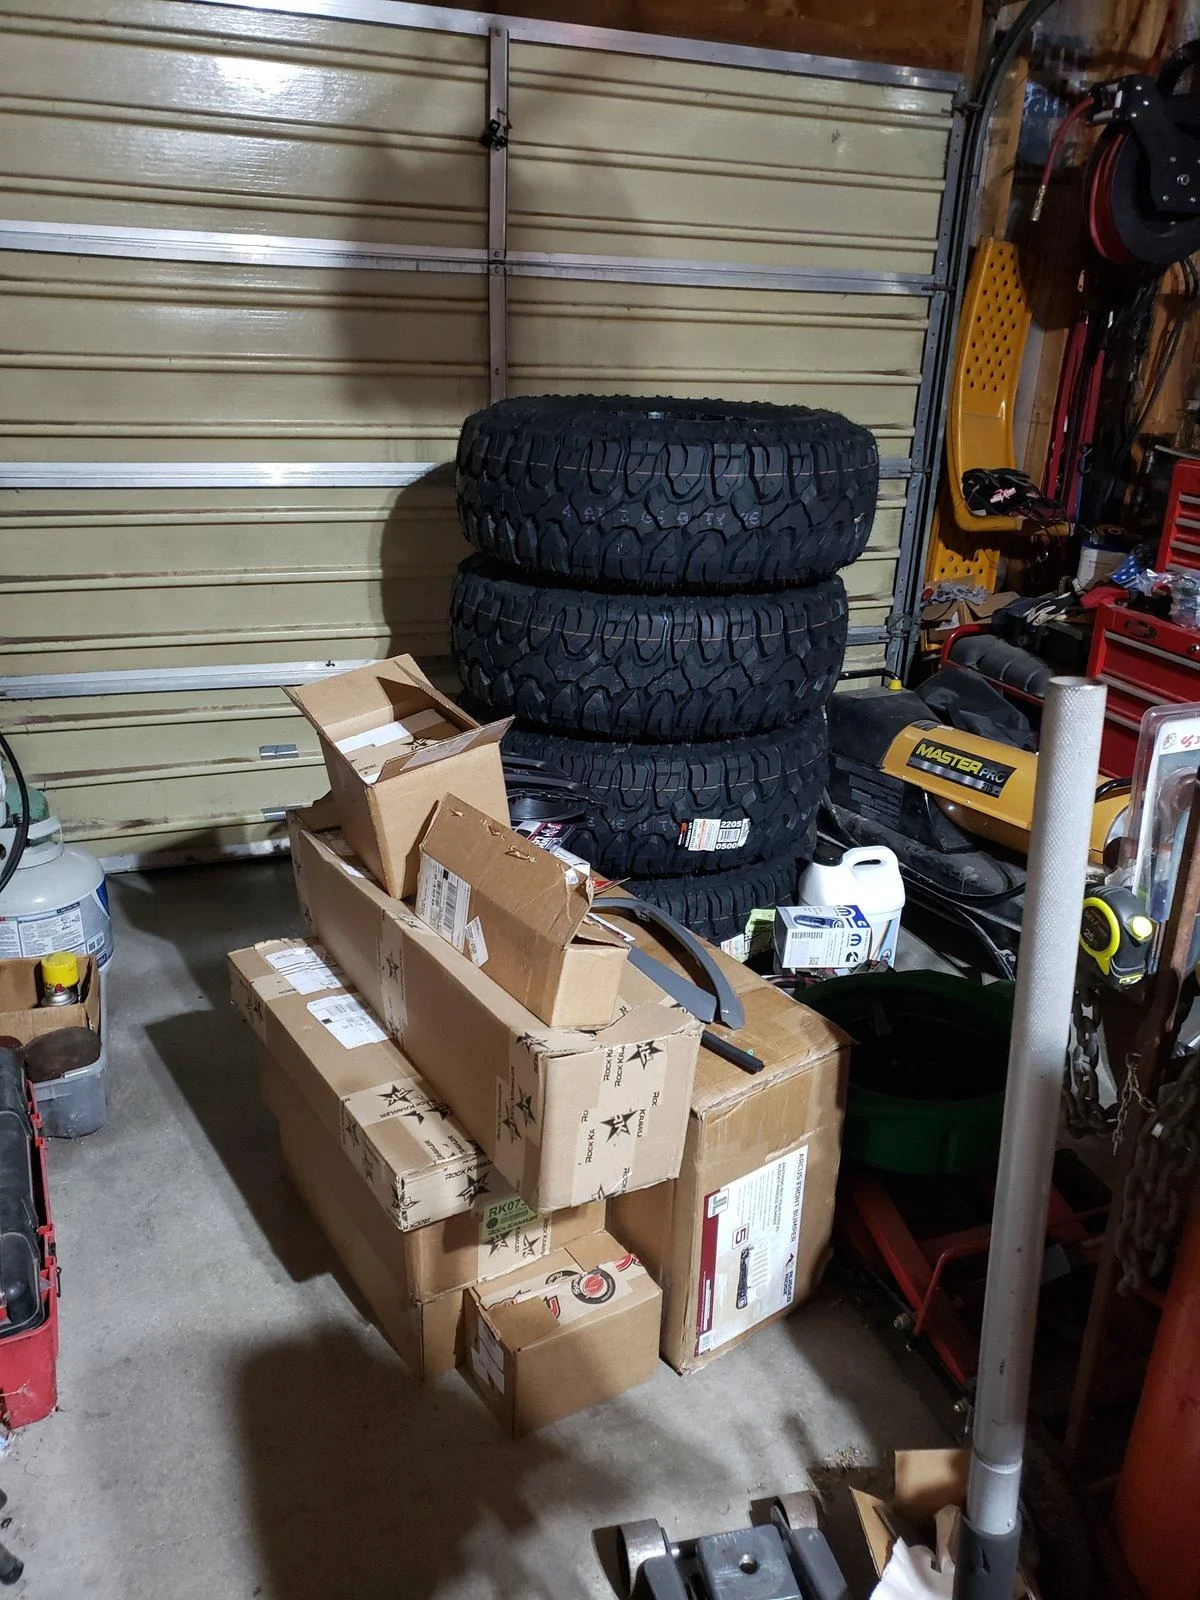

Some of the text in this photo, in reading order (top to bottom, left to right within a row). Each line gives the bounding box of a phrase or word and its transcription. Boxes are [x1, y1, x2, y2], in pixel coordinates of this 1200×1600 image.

[915, 743, 1006, 783] MASTER PRO
[980, 782, 994, 792] 215
[720, 821, 742, 829] 2205
[603, 1058, 613, 1082] ROCK
[614, 1064, 624, 1088] ROCK
[585, 1140, 595, 1164] ROCK
[444, 1169, 466, 1181] ROCK
[791, 1153, 805, 1243] ARCUS FRONT BUMPER
[735, 1227, 747, 1245] 5
